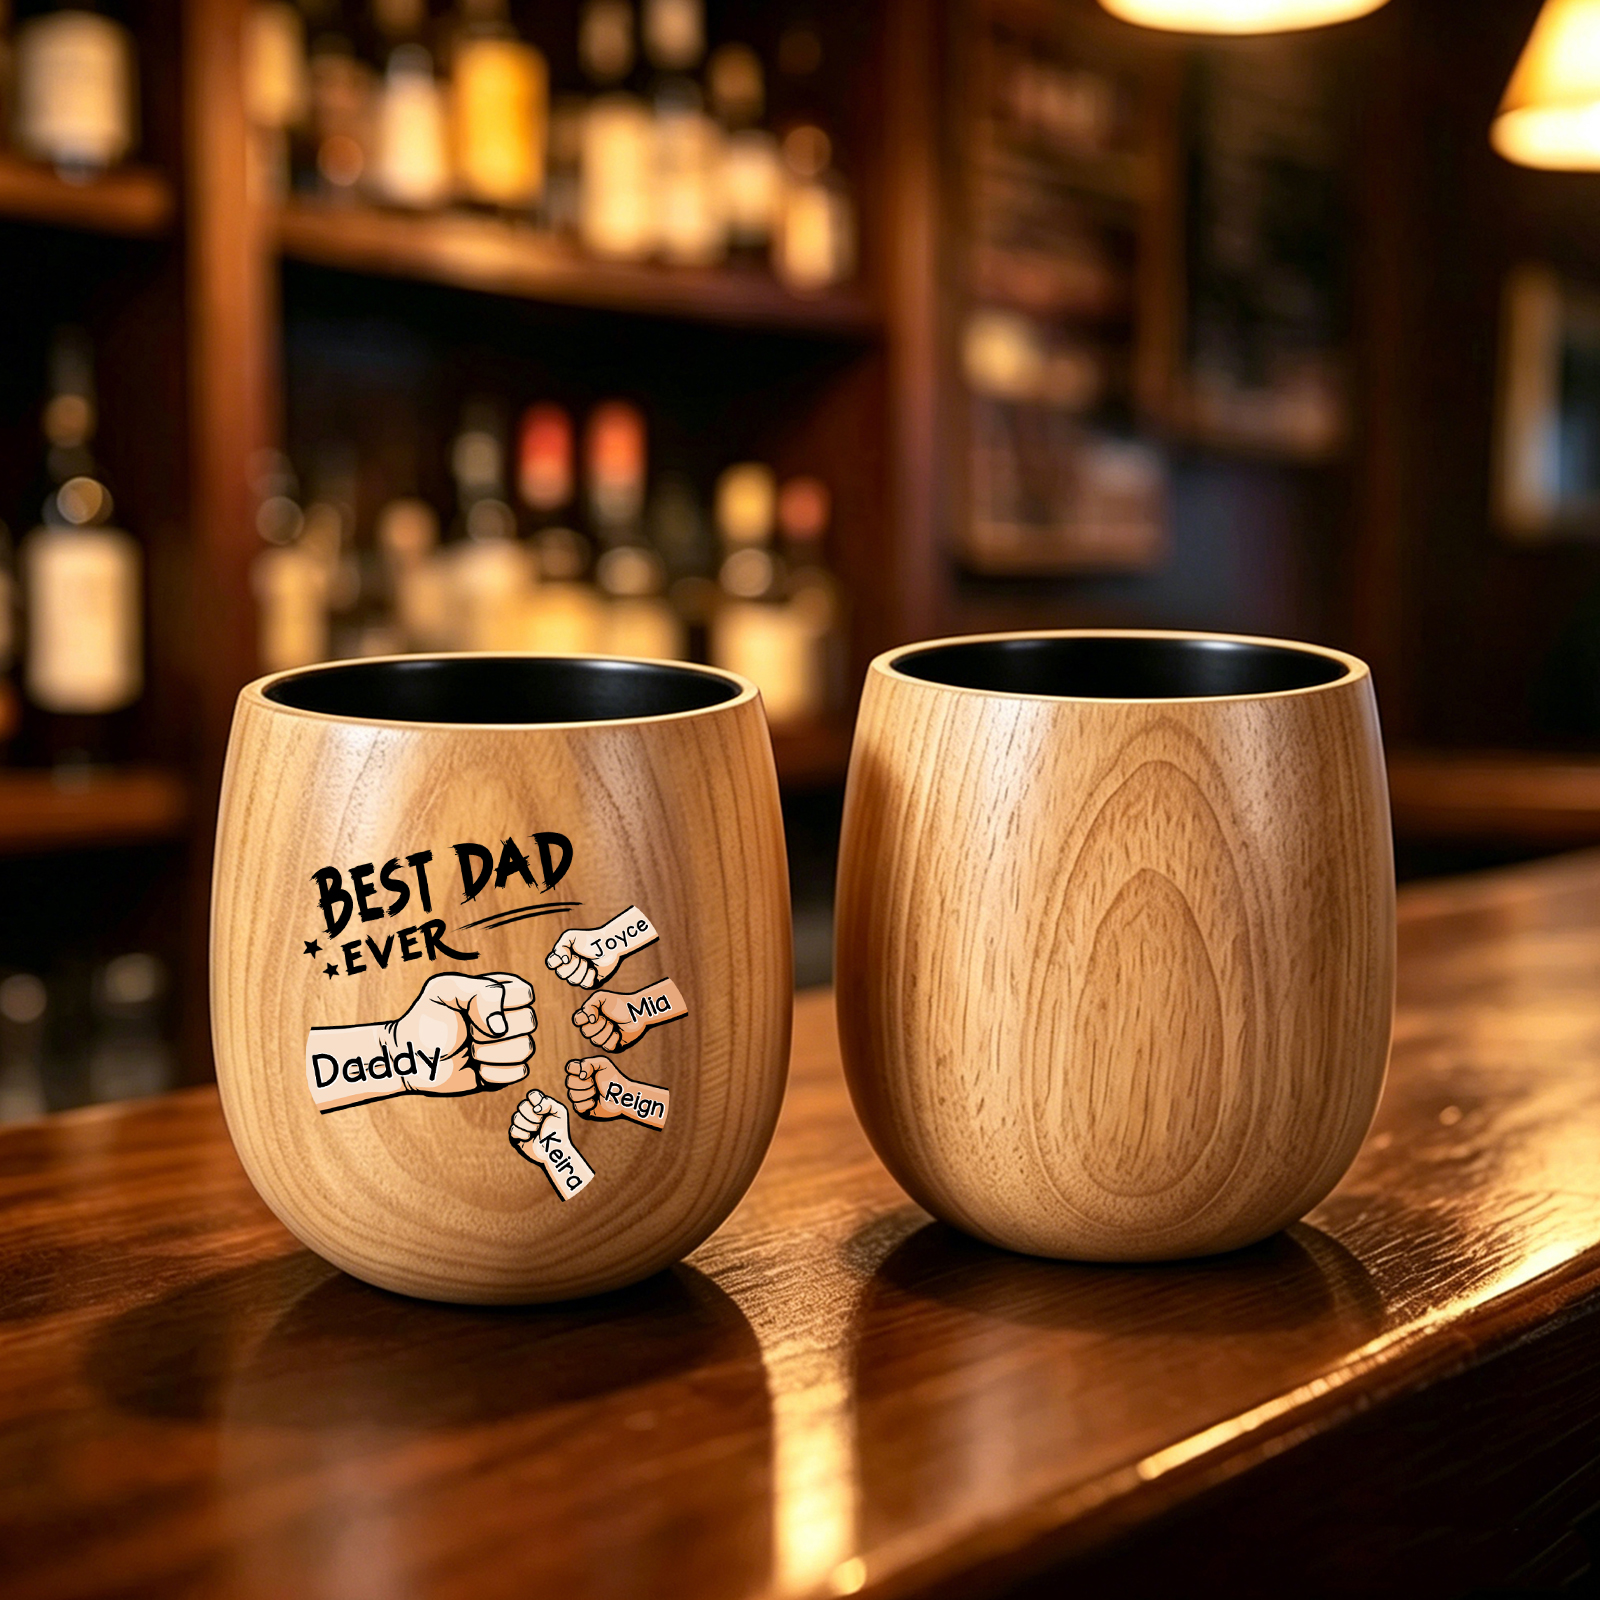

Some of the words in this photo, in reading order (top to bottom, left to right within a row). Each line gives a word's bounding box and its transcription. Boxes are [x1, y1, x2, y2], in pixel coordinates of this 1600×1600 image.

[310, 849, 433, 939] BEST
[449, 831, 574, 904] DAD
[341, 918, 480, 976] EVER
[590, 917, 649, 958] Joyce
[626, 994, 672, 1024] Mia
[311, 1041, 441, 1088] Daddy
[604, 1081, 665, 1119] Reign
[538, 1131, 583, 1192] Keira
